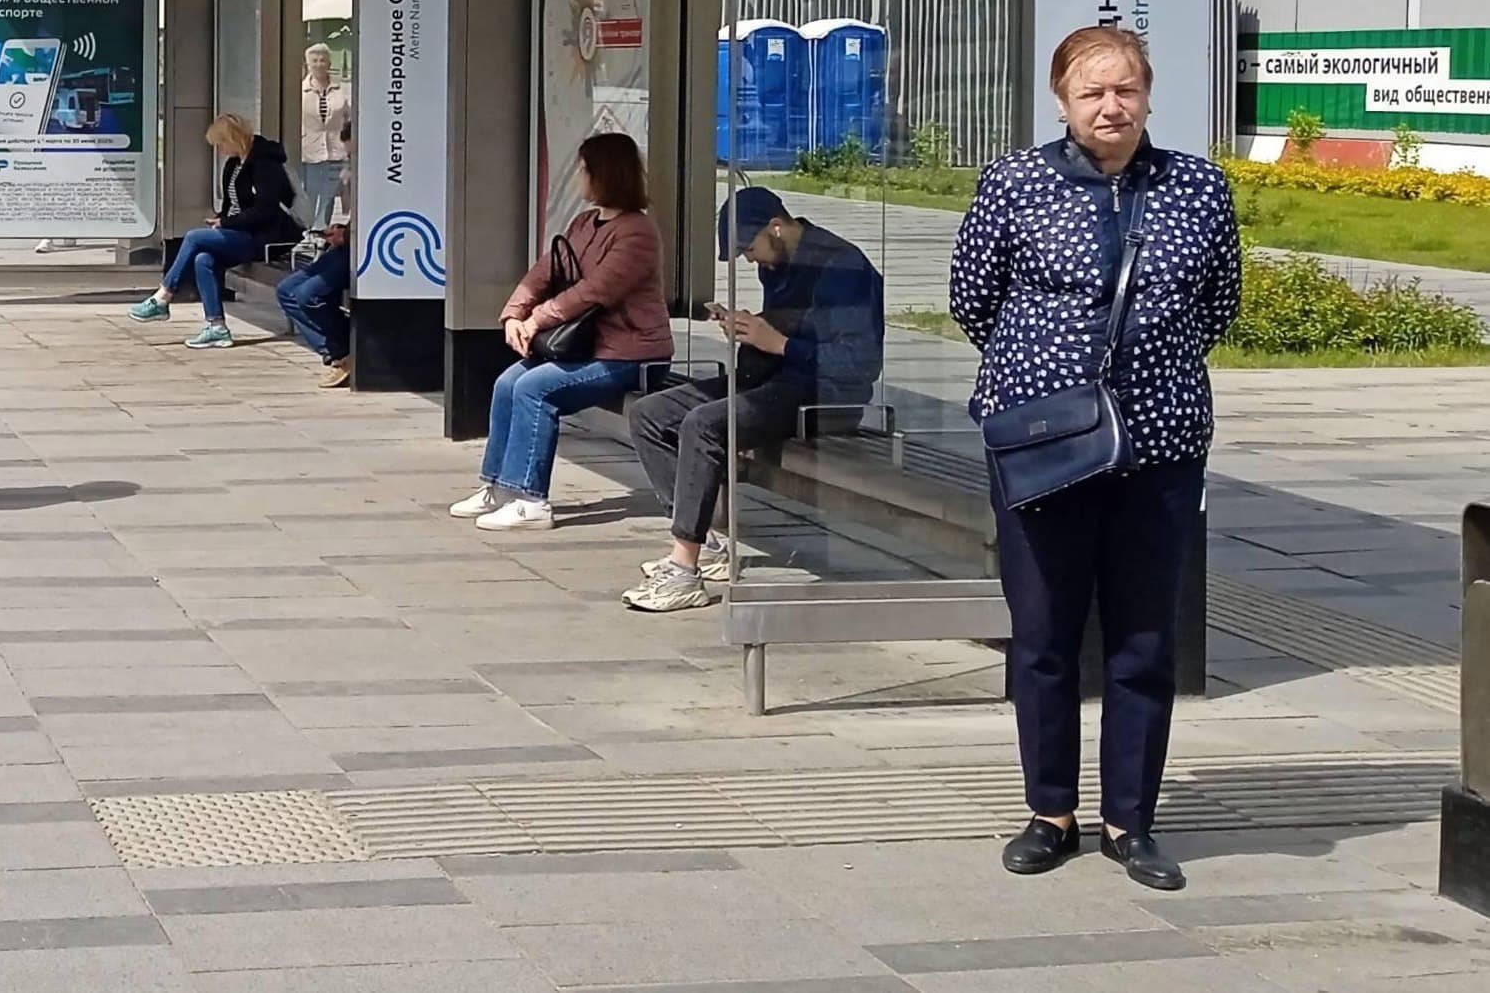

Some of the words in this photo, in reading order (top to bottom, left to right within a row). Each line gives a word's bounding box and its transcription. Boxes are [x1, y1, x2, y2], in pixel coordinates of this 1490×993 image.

[410, 22, 421, 60] Metro
[387, 8, 406, 116] «Народное
[1266, 53, 1318, 74] самый
[1323, 51, 1439, 74] экологичный
[1373, 87, 1399, 105] вид
[387, 120, 406, 184] Метро
